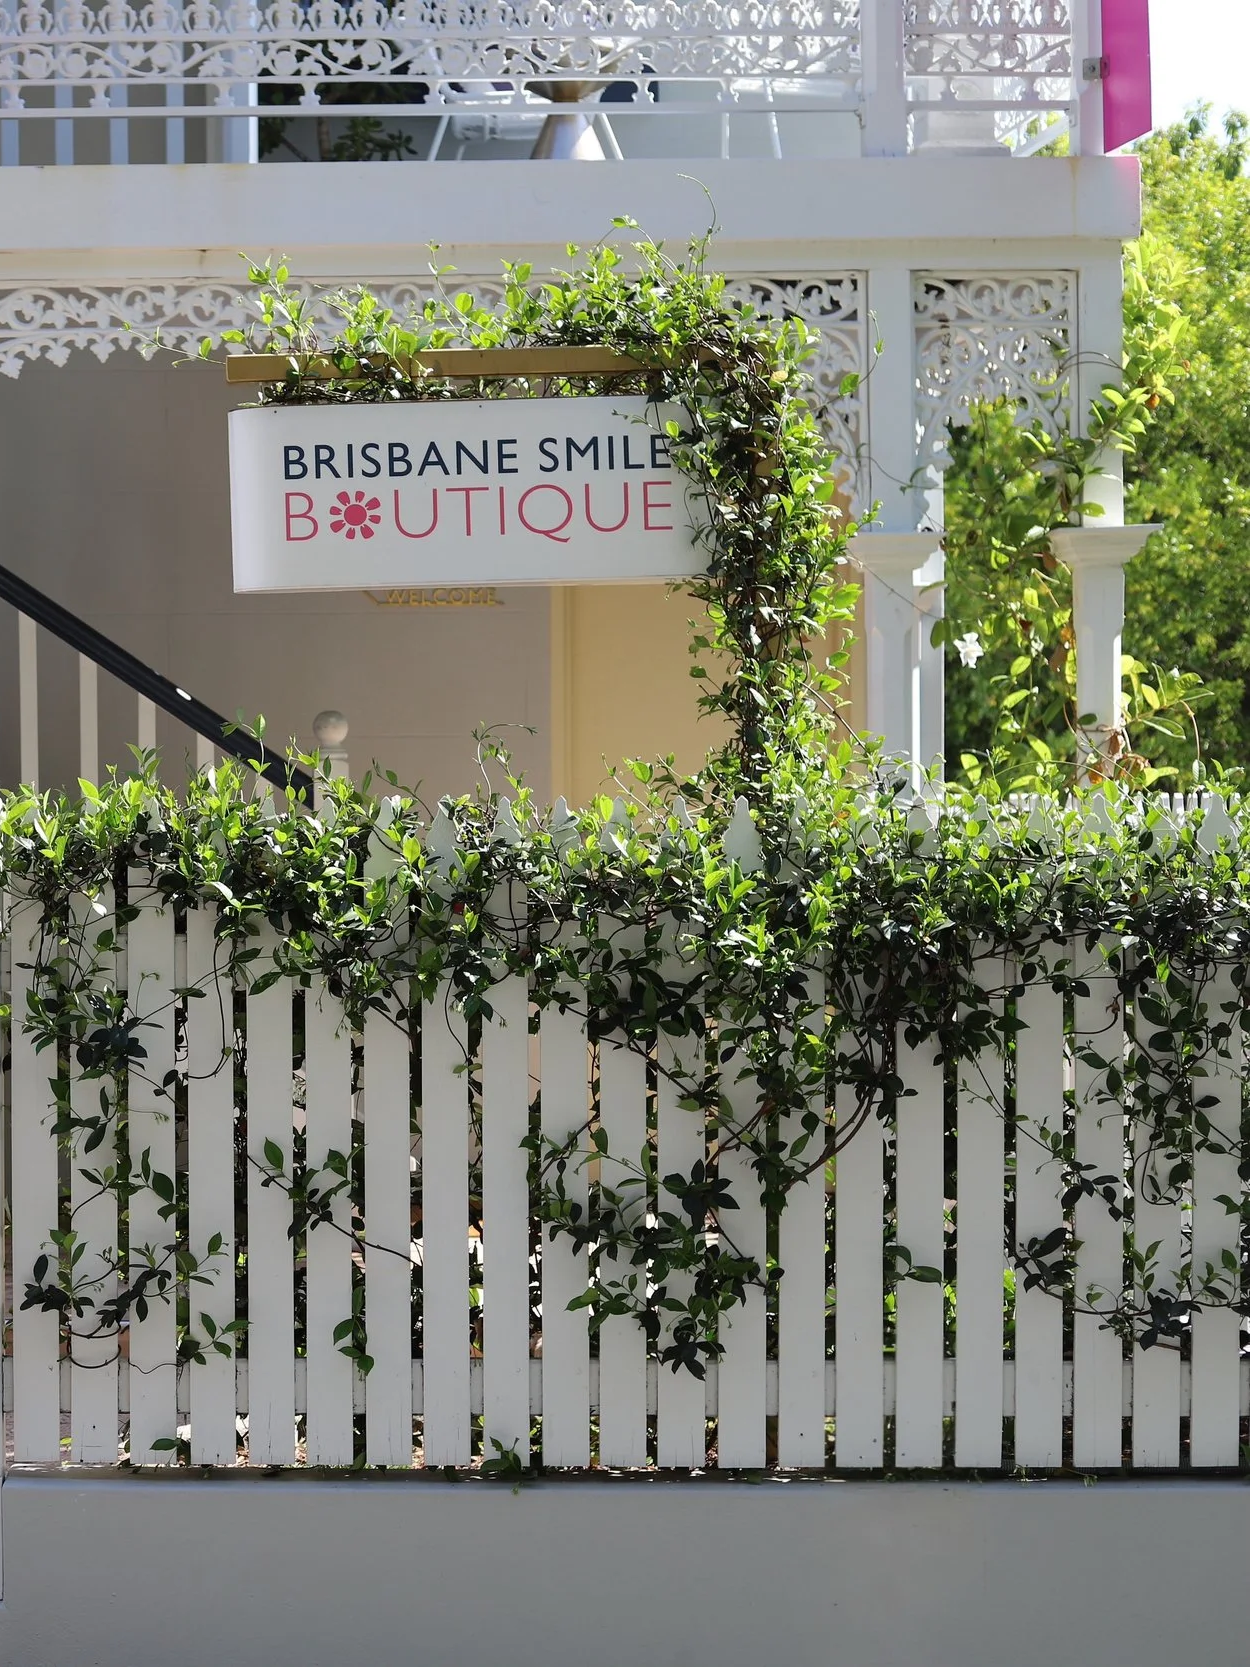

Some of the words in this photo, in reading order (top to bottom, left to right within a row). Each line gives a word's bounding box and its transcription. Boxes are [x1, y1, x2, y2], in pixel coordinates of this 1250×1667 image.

[283, 438, 518, 480] BRISBANE
[538, 434, 672, 473] SMILE
[385, 587, 498, 607] WELCOME
